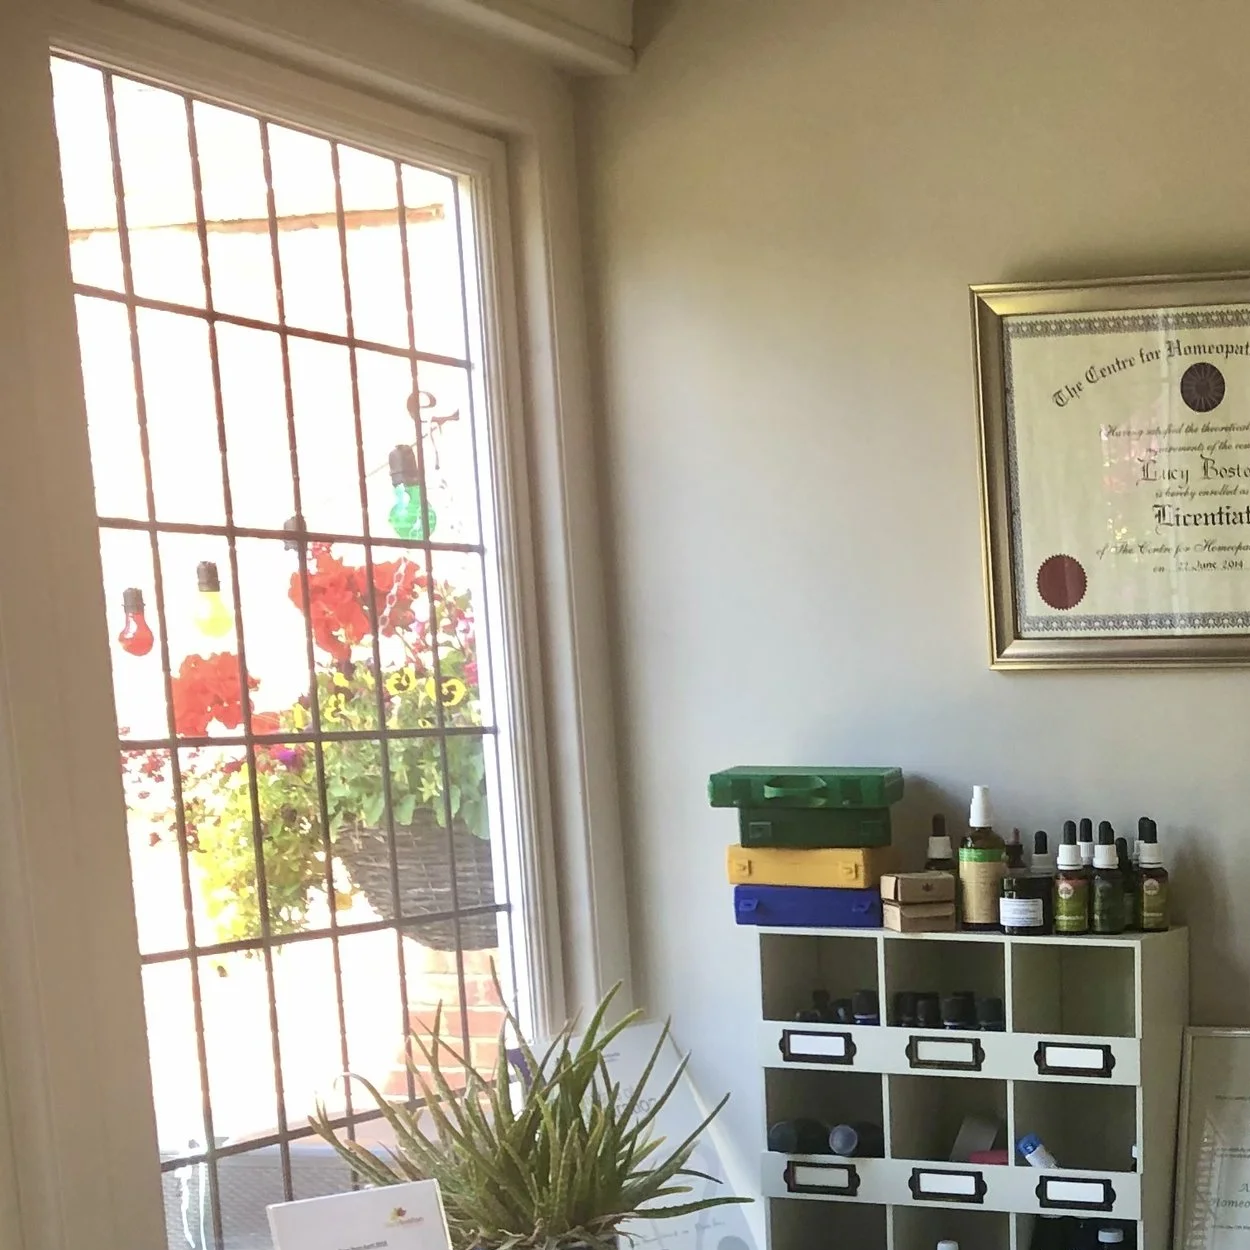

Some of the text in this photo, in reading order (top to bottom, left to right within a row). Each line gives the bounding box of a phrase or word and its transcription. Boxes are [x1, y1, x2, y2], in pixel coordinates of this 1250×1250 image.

[1051, 381, 1083, 408] The
[1085, 355, 1137, 385] Centre
[1139, 346, 1162, 365] for
[1184, 422, 1199, 433] the
[1206, 440, 1218, 455] of
[1218, 439, 1233, 450] the
[1136, 457, 1189, 486] Lucy
[1238, 1182, 1250, 1193] A
